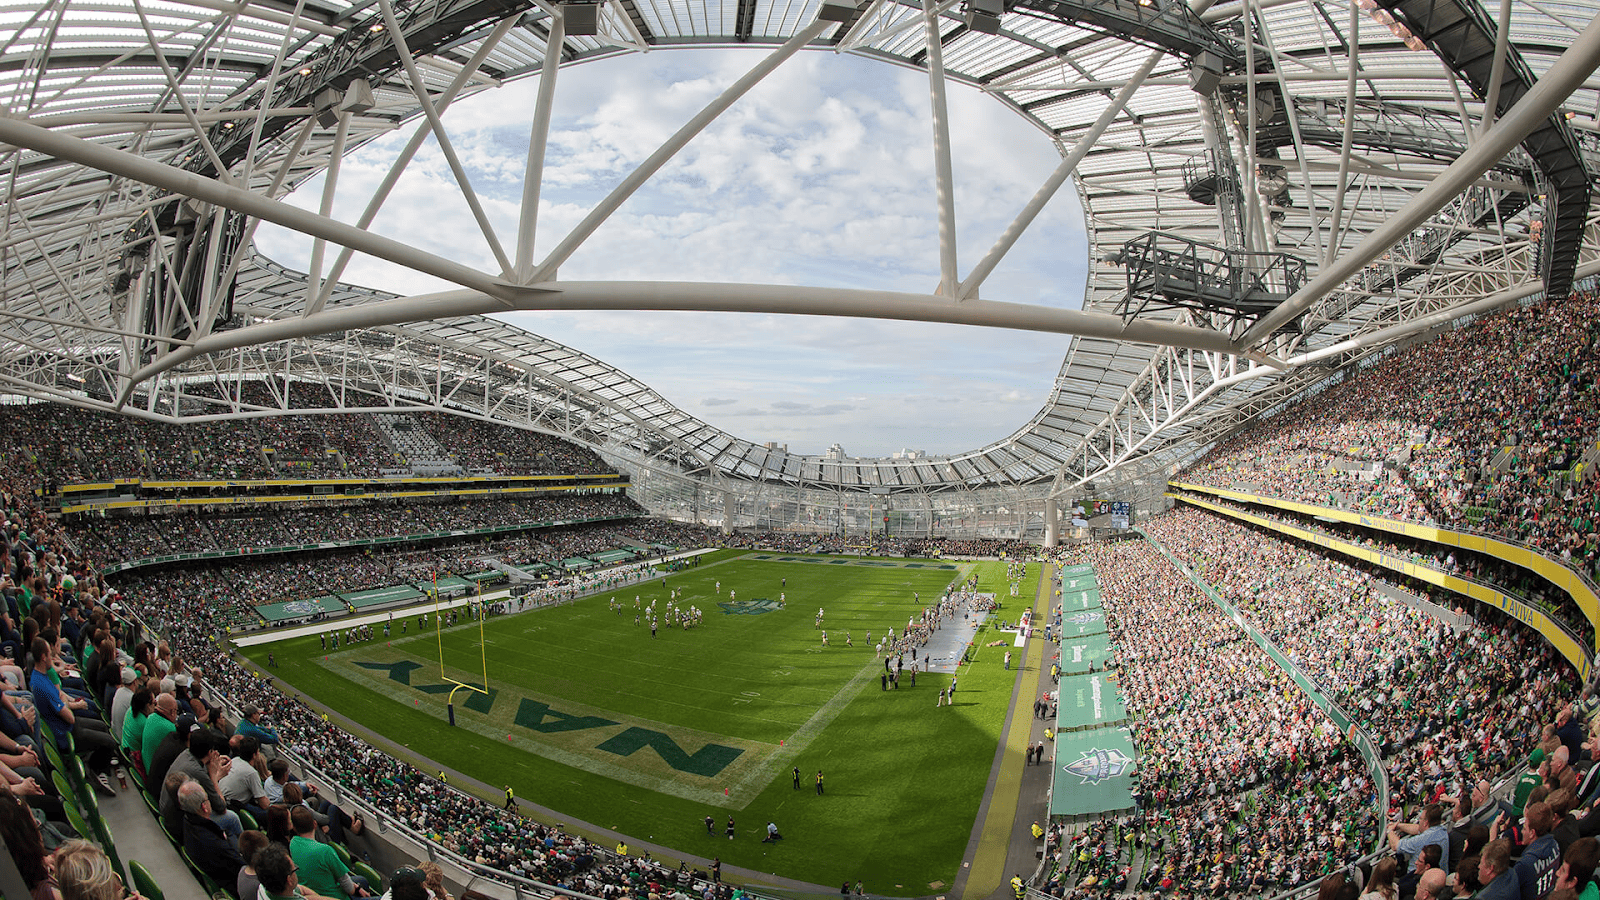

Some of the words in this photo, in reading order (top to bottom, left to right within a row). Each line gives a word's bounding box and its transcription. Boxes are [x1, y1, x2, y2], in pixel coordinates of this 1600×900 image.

[1385, 556, 1405, 571] AVIVA
[1509, 600, 1533, 626] AVIVA
[351, 660, 746, 778] NAVY
[1536, 868, 1555, 895] 117
